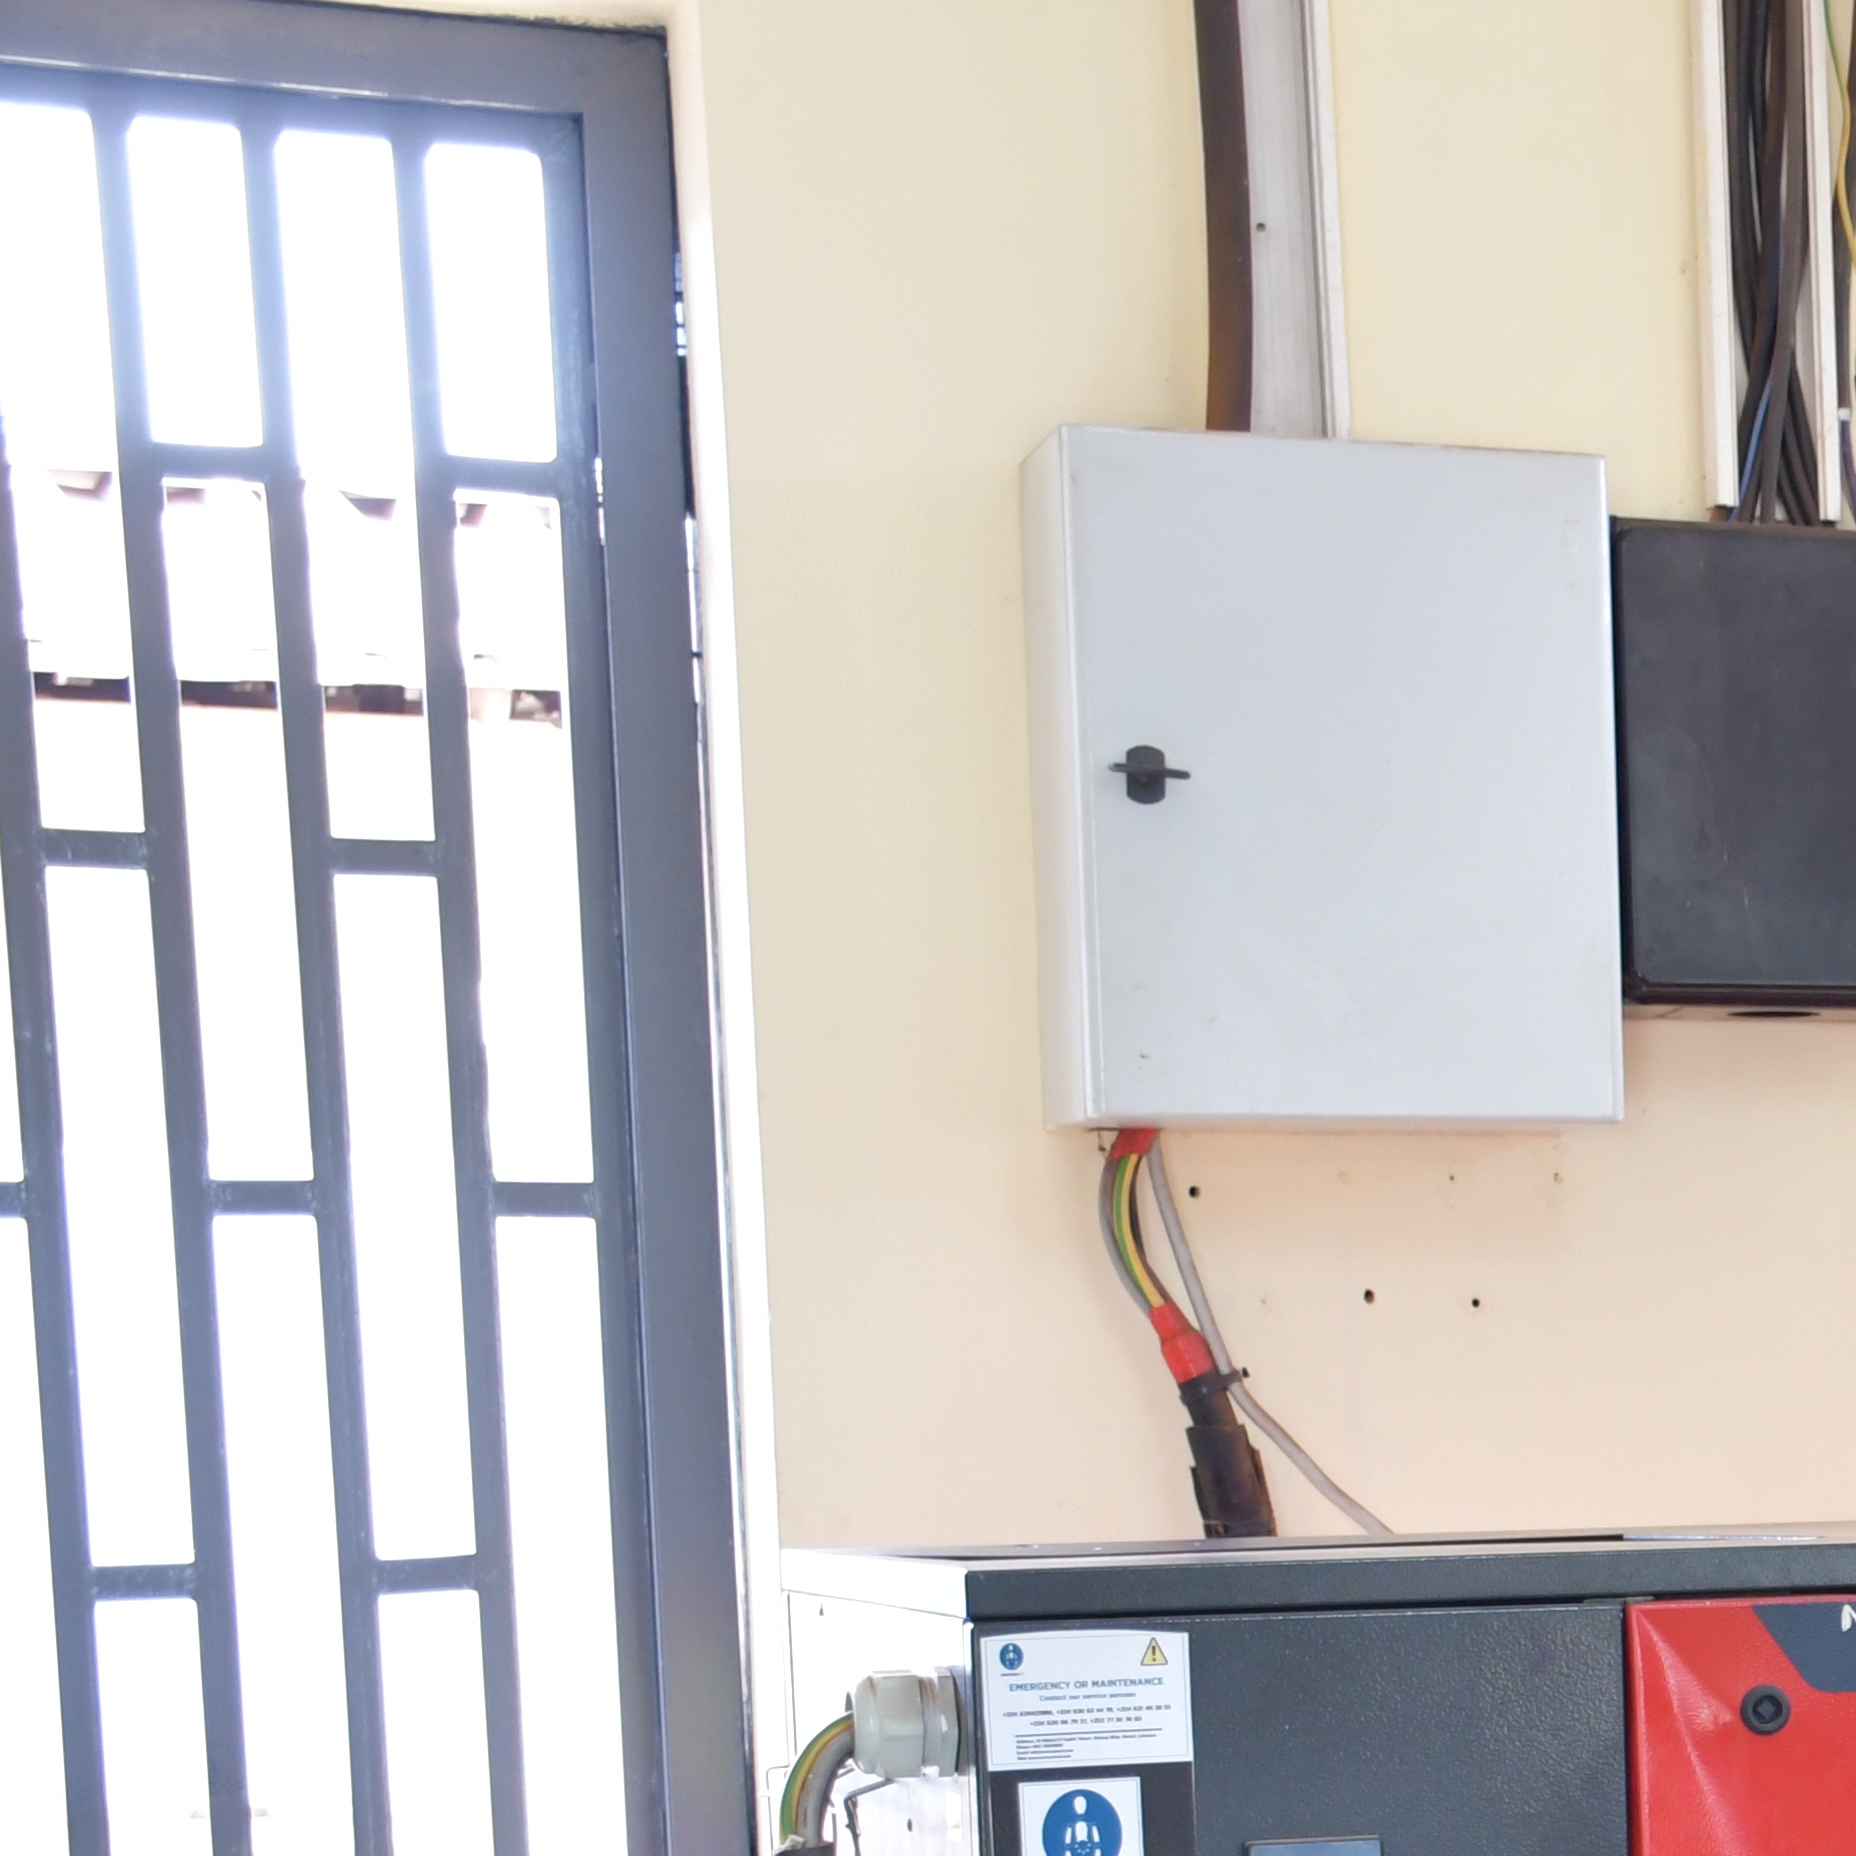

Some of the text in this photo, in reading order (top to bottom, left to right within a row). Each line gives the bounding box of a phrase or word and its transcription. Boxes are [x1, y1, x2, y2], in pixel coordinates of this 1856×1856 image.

[1009, 1677, 1164, 1692] EMERGENCY OR MAINTENANCE
